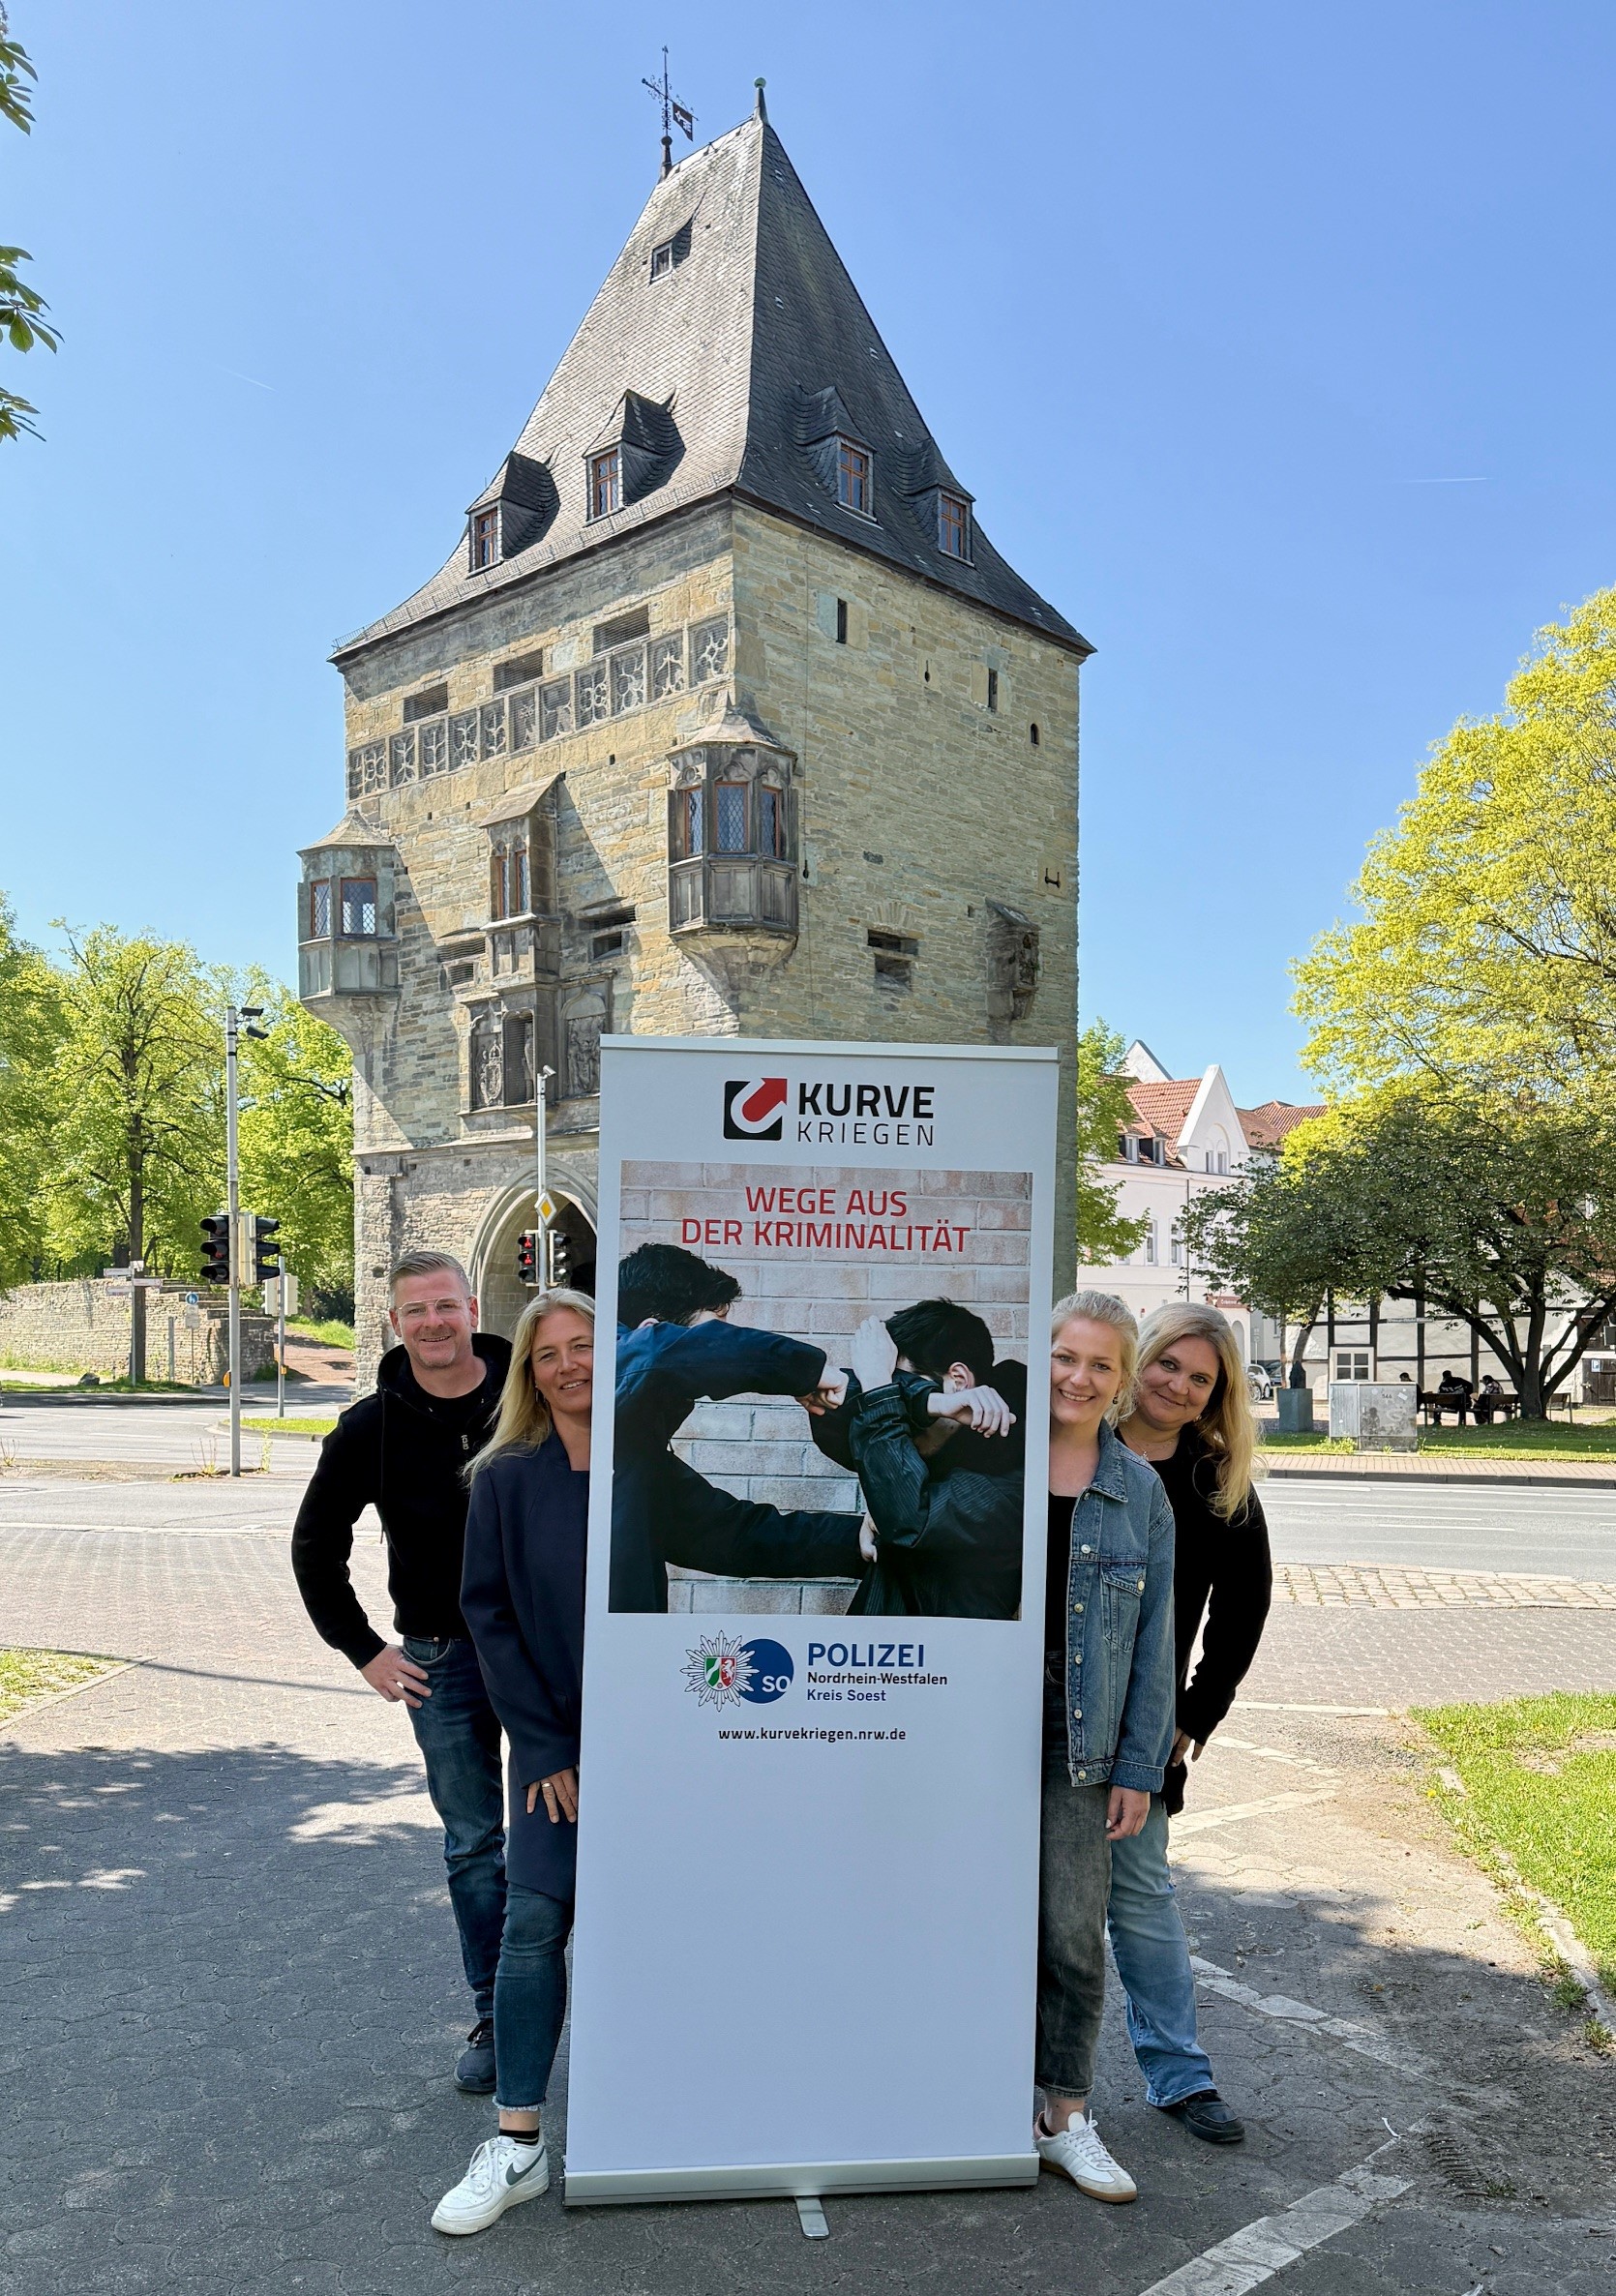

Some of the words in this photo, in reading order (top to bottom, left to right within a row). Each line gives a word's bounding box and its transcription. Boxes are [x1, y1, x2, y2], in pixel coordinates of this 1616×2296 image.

[798, 1083, 935, 1118] KURVE
[797, 1120, 934, 1147] KRIEGEN
[745, 1186, 836, 1214] WEGE
[846, 1189, 908, 1217] AUS
[681, 1218, 743, 1245] DER
[754, 1219, 971, 1252] KRIMINALITÄT
[807, 1643, 925, 1668] POLIZEI
[762, 1676, 792, 1693] SO
[807, 1672, 948, 1685] Nordrhein-Westfalen
[807, 1689, 843, 1702] Kreis
[847, 1689, 886, 1702] Soest
[718, 1727, 907, 1743] www.kurvekriegen.nrw.de
